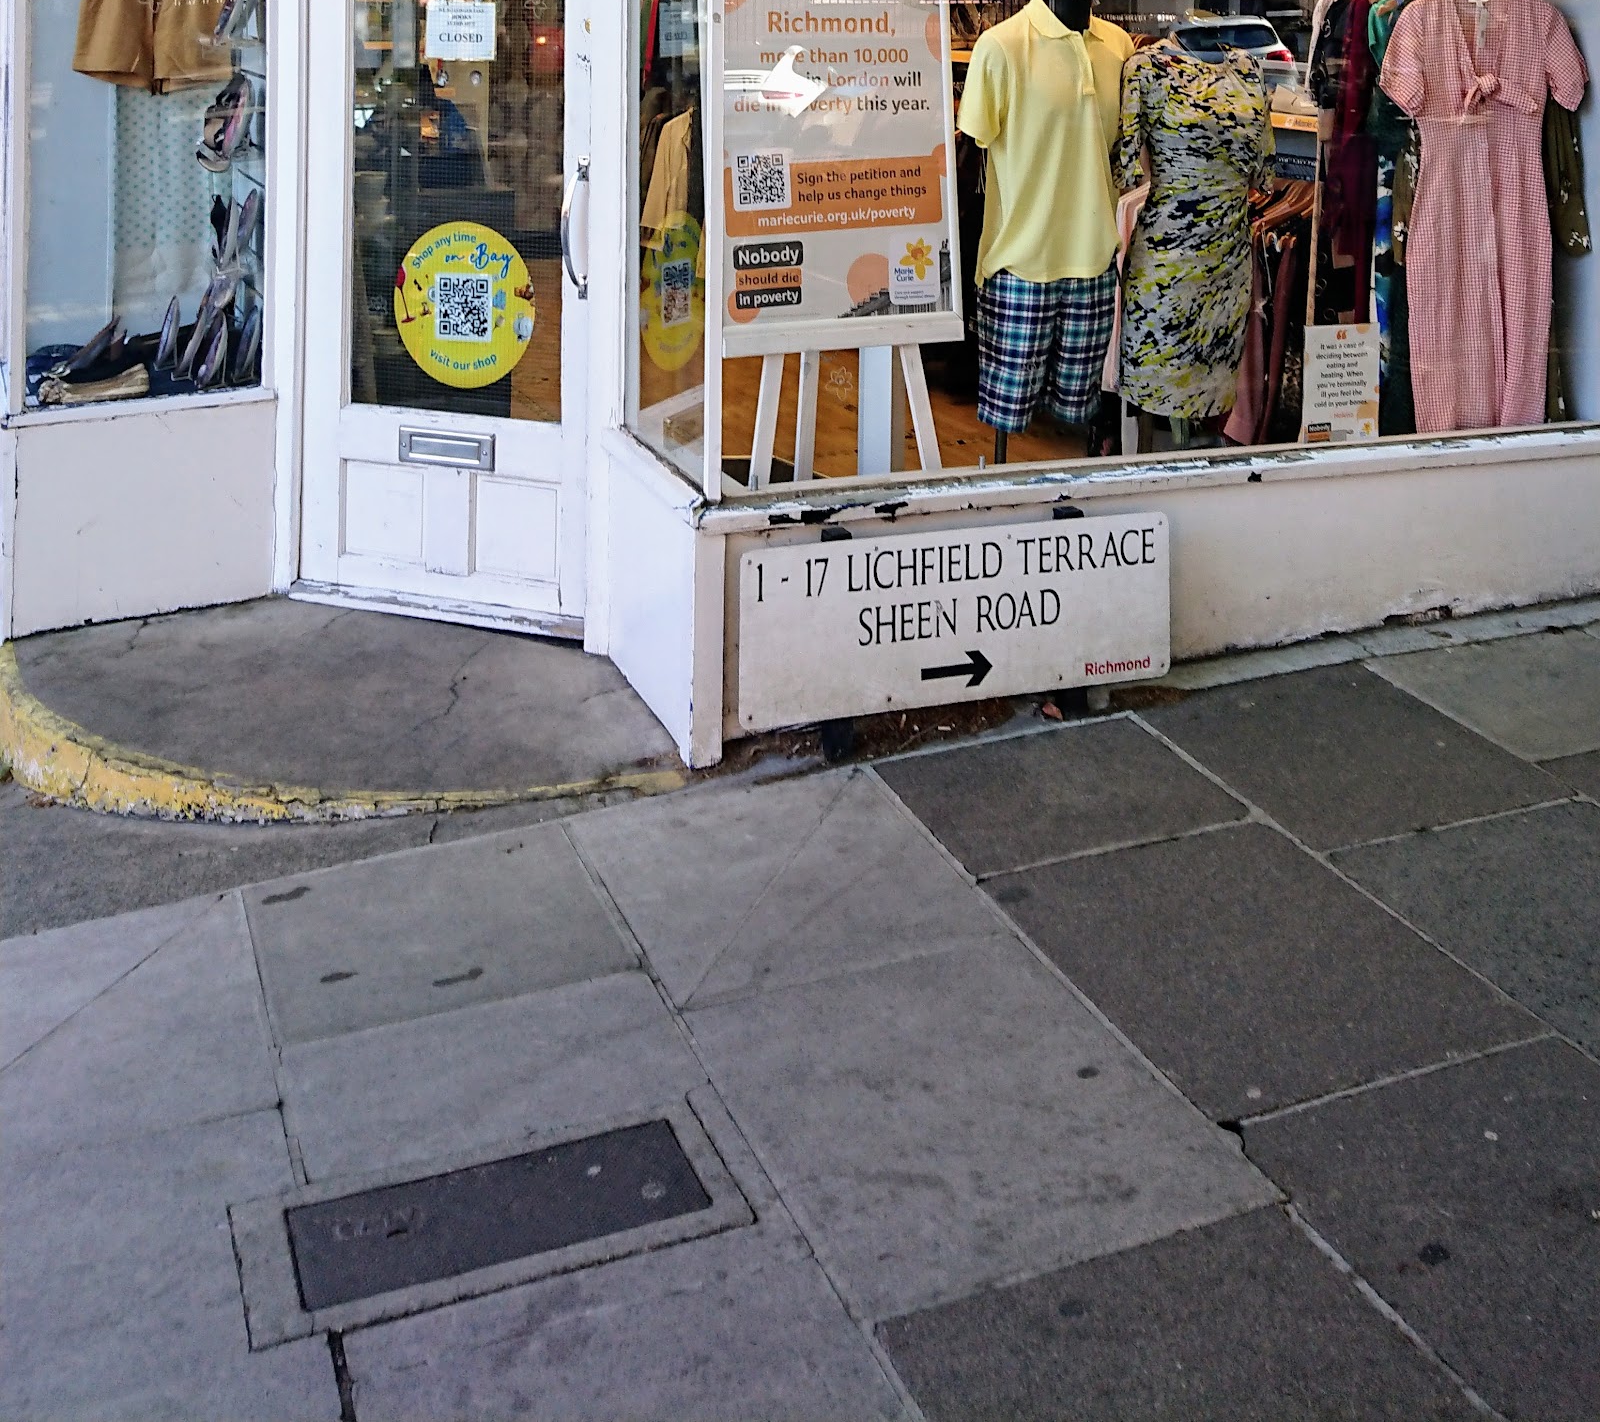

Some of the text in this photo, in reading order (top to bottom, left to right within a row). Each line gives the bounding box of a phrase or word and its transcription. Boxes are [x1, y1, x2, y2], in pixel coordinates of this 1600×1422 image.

[768, 11, 896, 37] Richmond,
[439, 33, 483, 43] CLOSED
[760, 48, 908, 65] moe than 10,000
[828, 72, 889, 88] London
[894, 71, 922, 87] will
[734, 95, 760, 112] die
[857, 96, 887, 111] this
[892, 99, 930, 115] year.
[797, 166, 921, 186] Sign the petition and
[798, 185, 927, 204] help us change things
[757, 206, 915, 227] mariecurie.org.uk/poverty
[435, 235, 451, 249] any
[453, 231, 476, 243] time
[445, 243, 514, 278] on eBay
[738, 246, 799, 266] Nobody
[739, 271, 799, 286] should die
[739, 289, 799, 308] in poverty
[430, 349, 497, 371] visit our shop
[1352, 388, 1362, 396] the
[756, 564, 764, 603] 1
[805, 558, 829, 598] 17
[847, 541, 1003, 593] LICHFIELD
[1016, 527, 1157, 576] TERRACE
[858, 588, 1061, 647] SHEEN ROAD
[1084, 655, 1151, 677] Richmond
